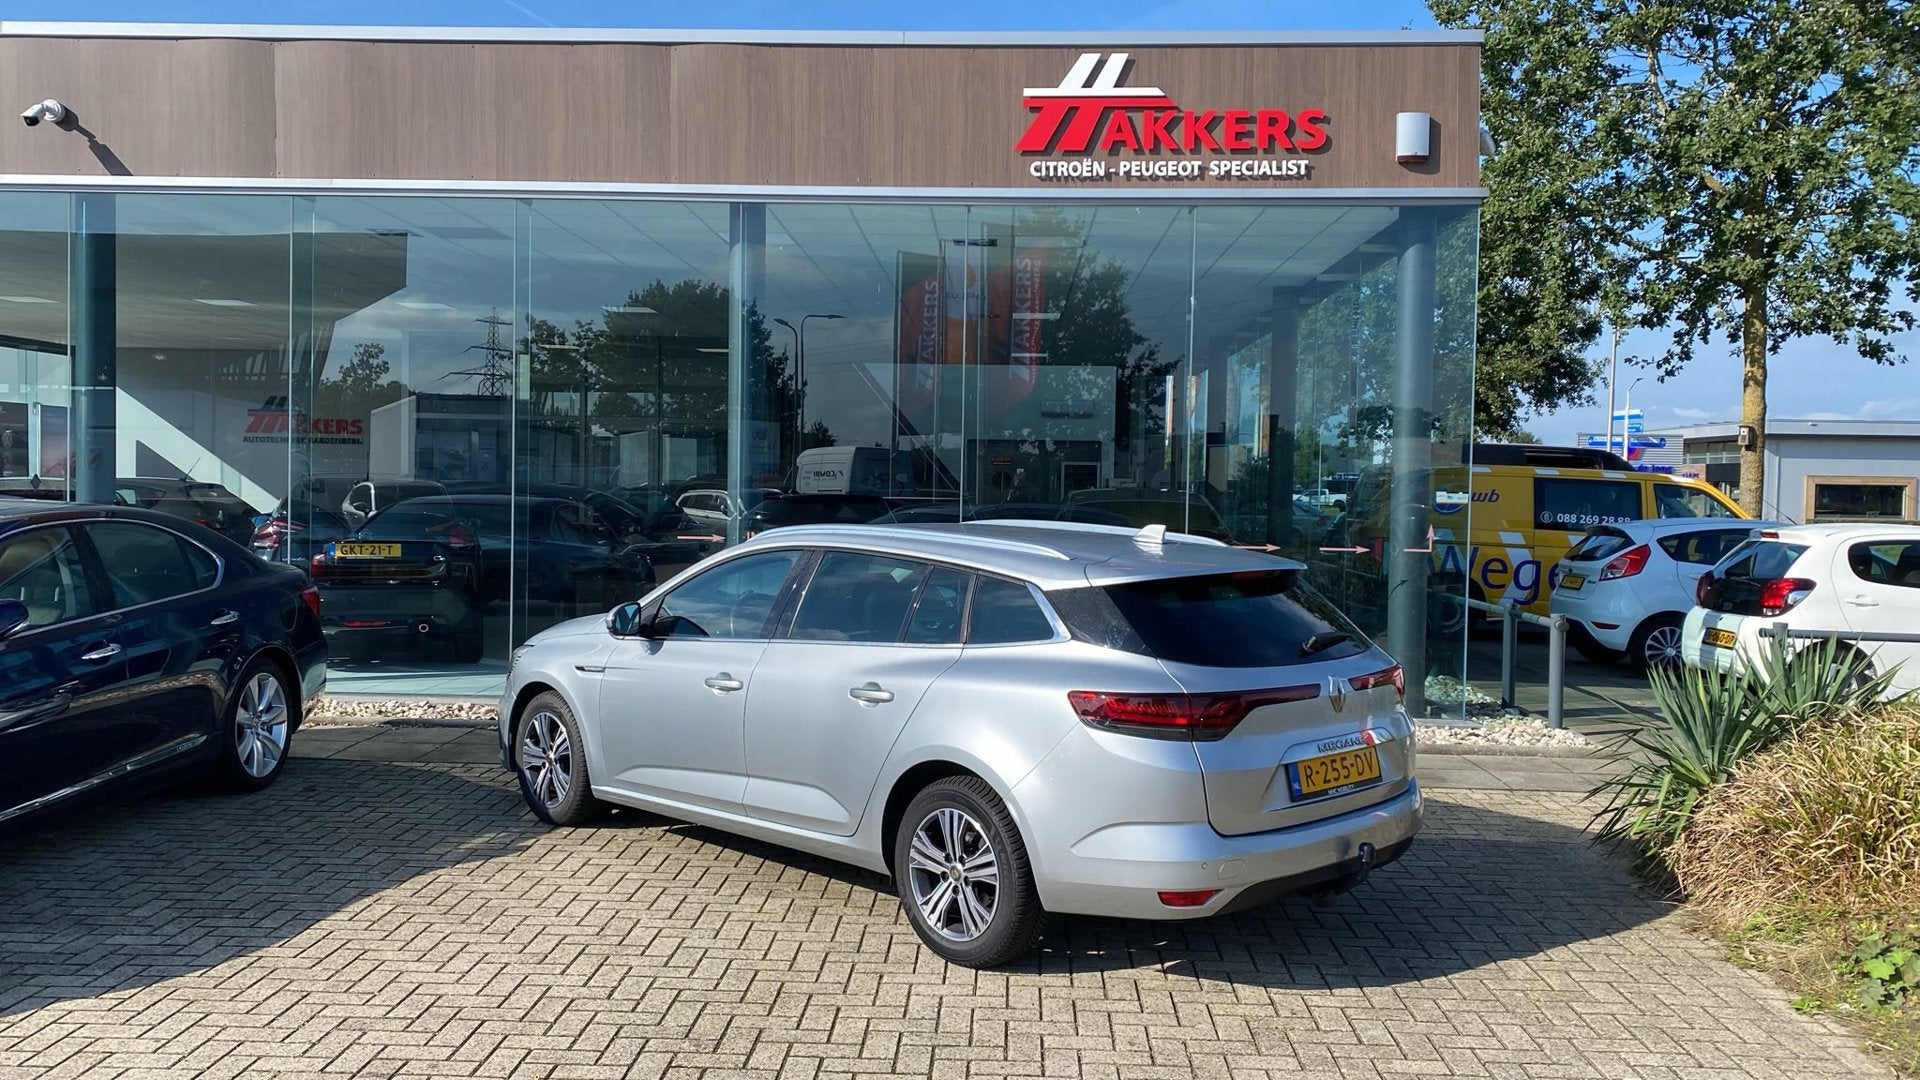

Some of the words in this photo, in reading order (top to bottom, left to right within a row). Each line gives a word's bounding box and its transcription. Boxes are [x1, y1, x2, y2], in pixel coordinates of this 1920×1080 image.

[1029, 157, 1105, 177] CITROËN
[1119, 160, 1202, 177] PEUGEOT
[1209, 159, 1309, 176] SPECIALIST
[1557, 513, 1577, 523] 088
[1580, 515, 1600, 524] 269
[1602, 516, 1615, 525] 28
[340, 545, 393, 556] GKT-21-T
[1304, 751, 1373, 788] R-255-DV
